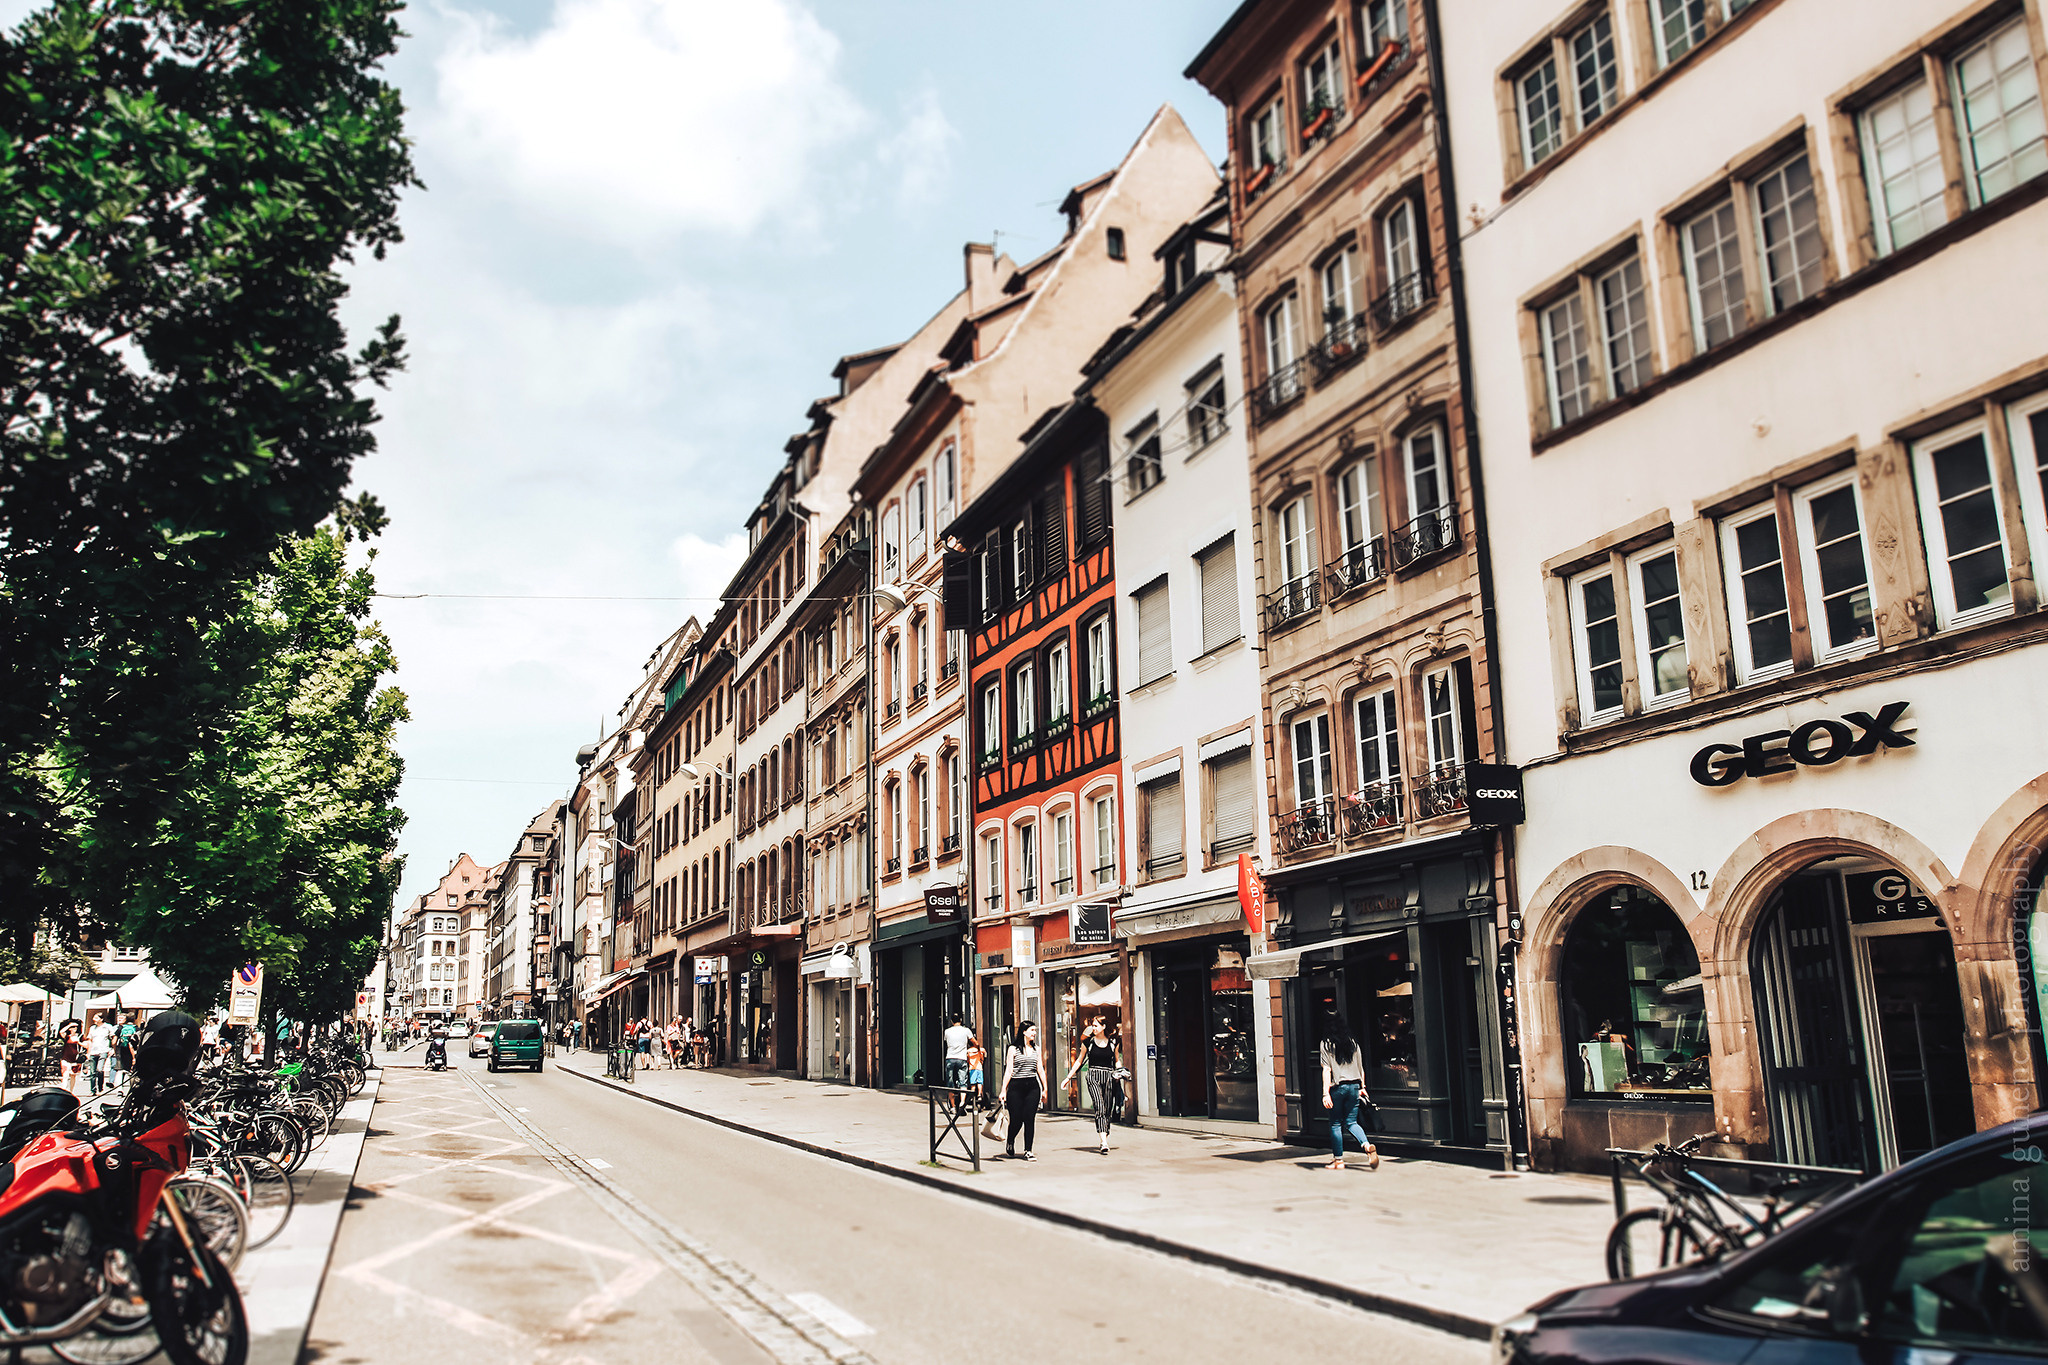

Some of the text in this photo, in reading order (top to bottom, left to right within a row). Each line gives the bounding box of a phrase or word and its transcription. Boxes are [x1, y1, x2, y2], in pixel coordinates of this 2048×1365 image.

[1690, 701, 1917, 787] GEOX
[1475, 788, 1519, 799] GEOX
[1690, 870, 1709, 891] 12
[929, 895, 957, 906] Gsell
[1246, 868, 1261, 917] TABAC
[1254, 945, 1263, 956] 16
